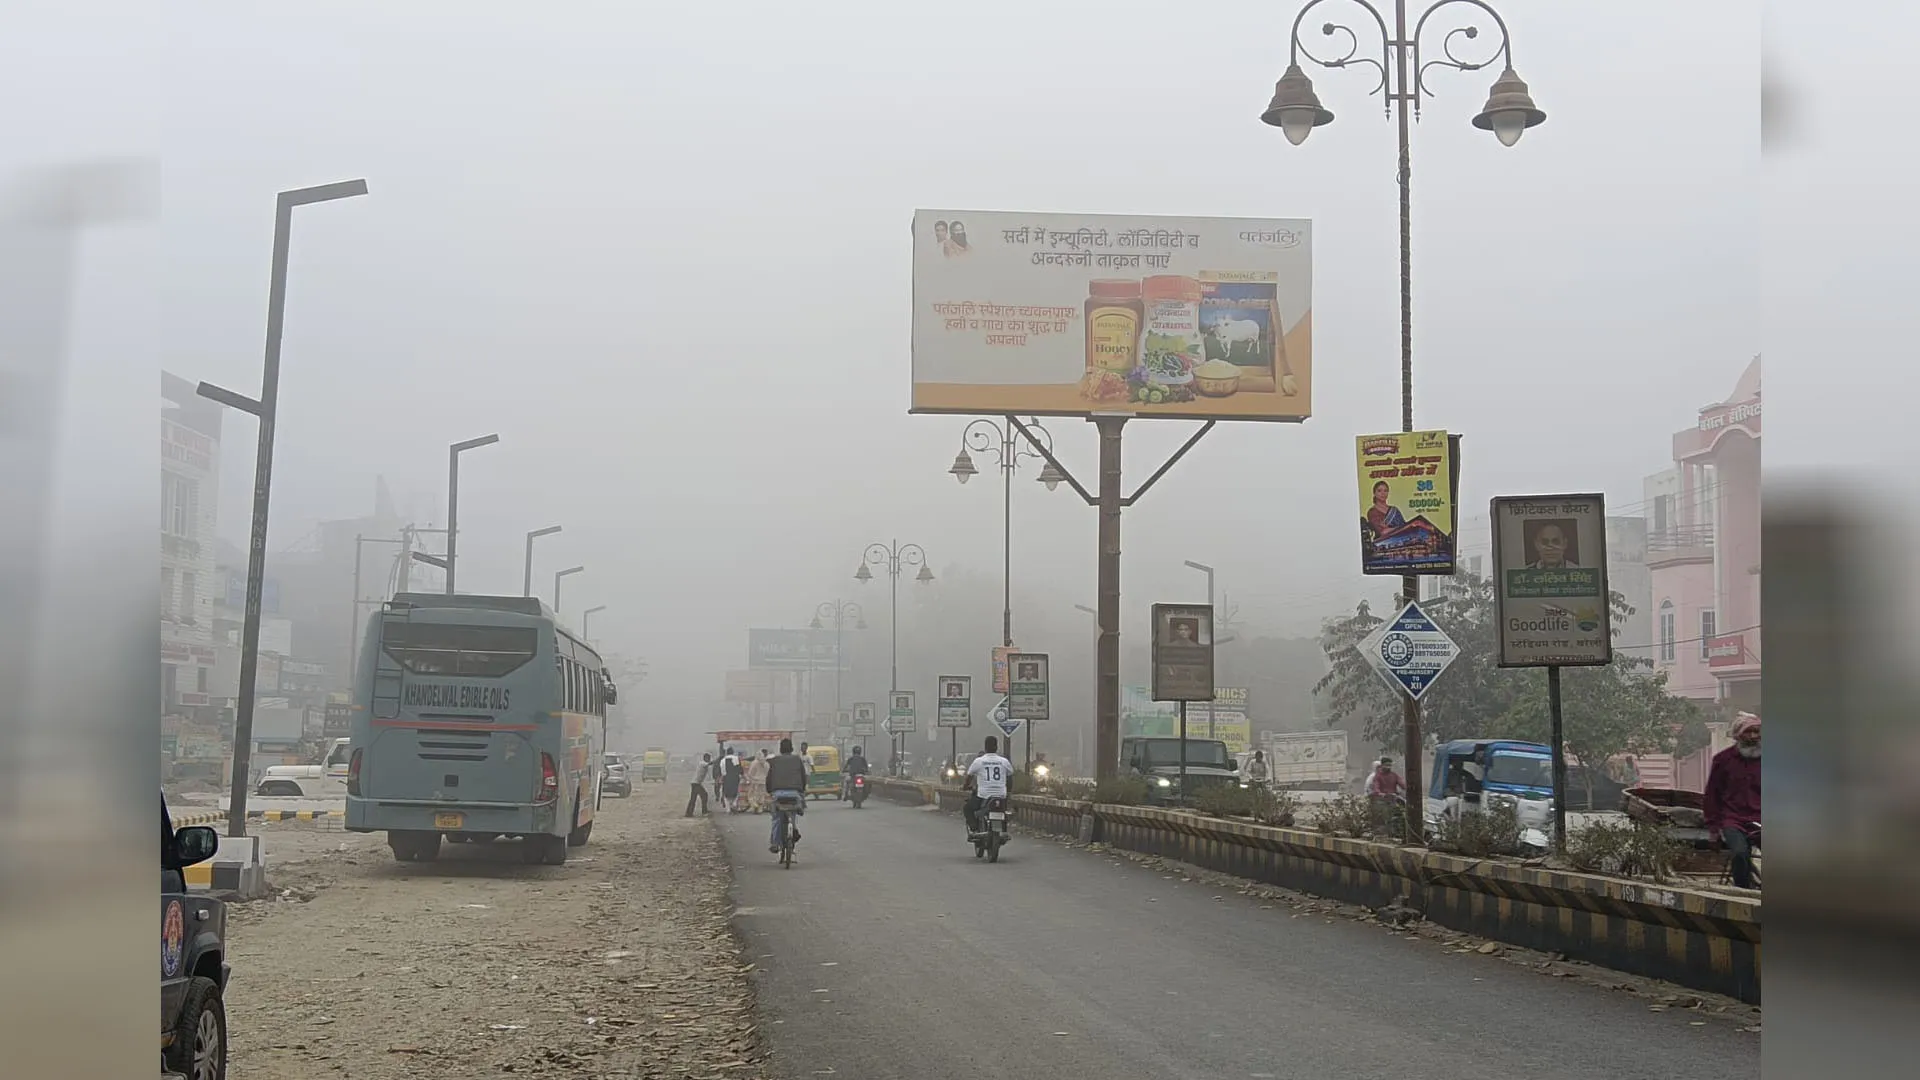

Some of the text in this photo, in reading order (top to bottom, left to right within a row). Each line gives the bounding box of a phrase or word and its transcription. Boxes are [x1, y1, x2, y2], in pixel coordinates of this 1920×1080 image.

[1002, 227, 1029, 246] सर्दी
[1034, 228, 1046, 245] में
[1188, 234, 1200, 249] व
[932, 301, 976, 317] पतंजलि
[1095, 343, 1132, 355] Honey
[1509, 617, 1569, 632] Goodlife
[1410, 681, 1423, 689] XII
[404, 683, 510, 710] KHANDELWAL EDIBLE OILS
[984, 766, 1001, 781] 18
